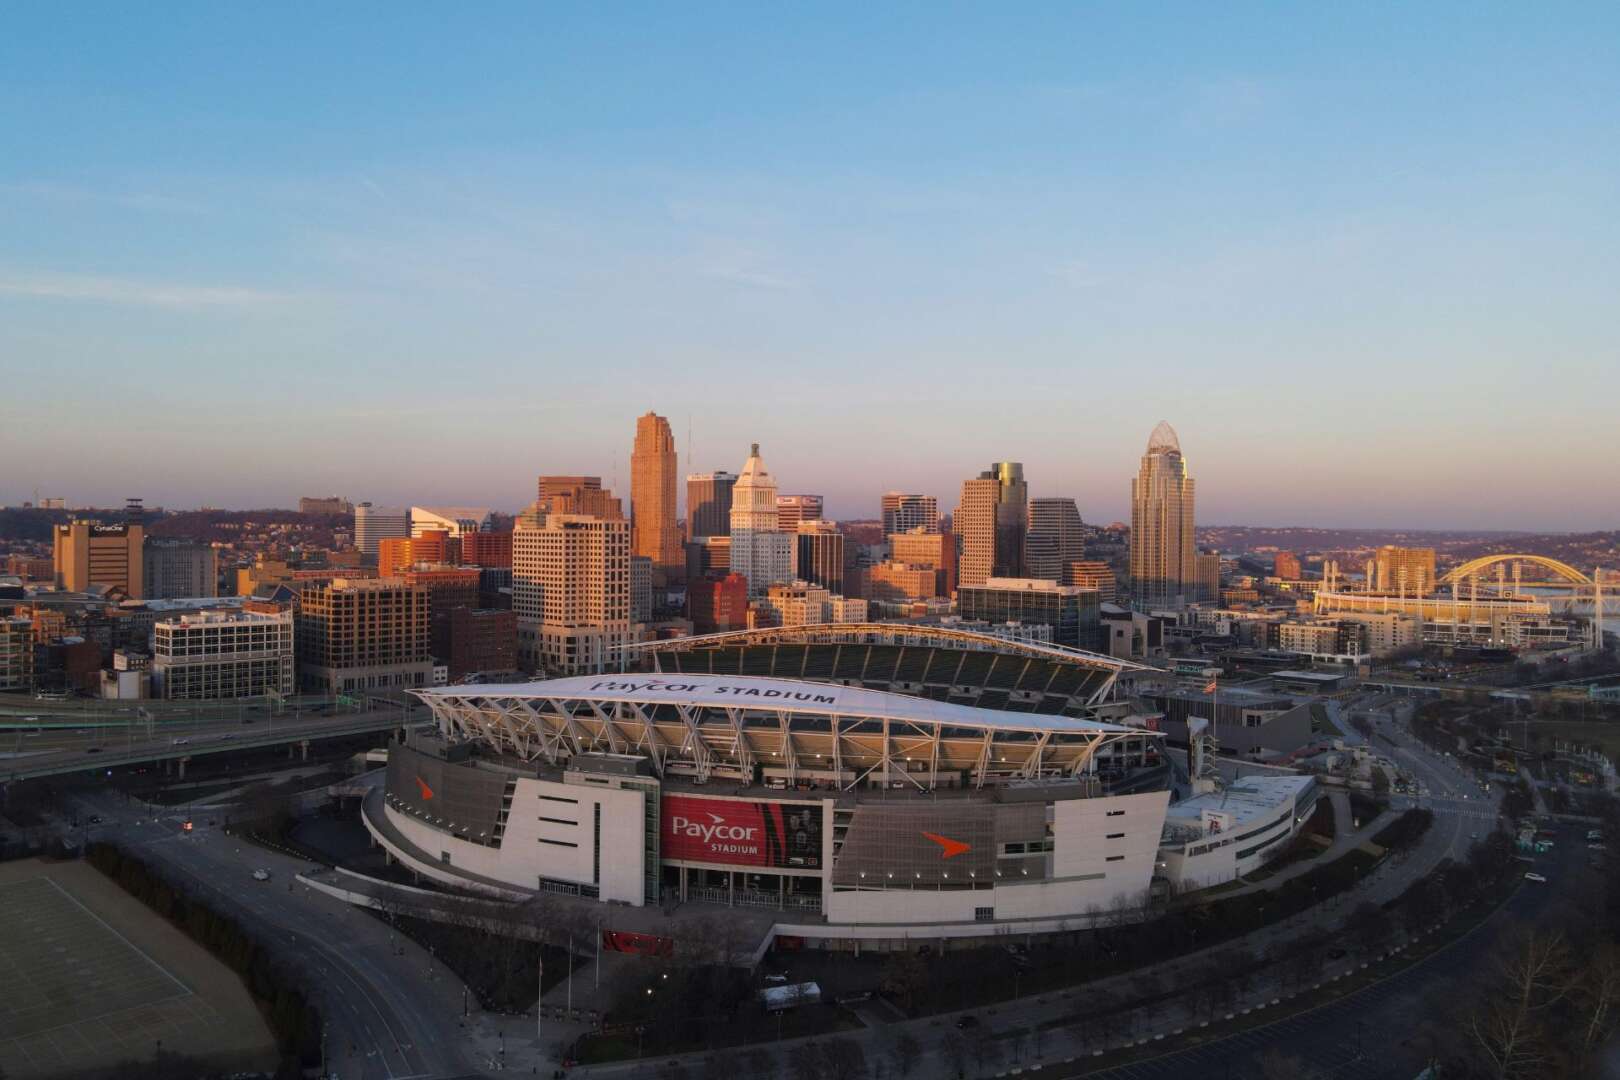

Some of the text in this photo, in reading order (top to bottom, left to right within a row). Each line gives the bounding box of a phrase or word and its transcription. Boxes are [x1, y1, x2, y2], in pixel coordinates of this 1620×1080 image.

[590, 681, 836, 704] Paycor STADIUM
[672, 816, 758, 843] Paycor
[711, 844, 758, 855] STADIUM
